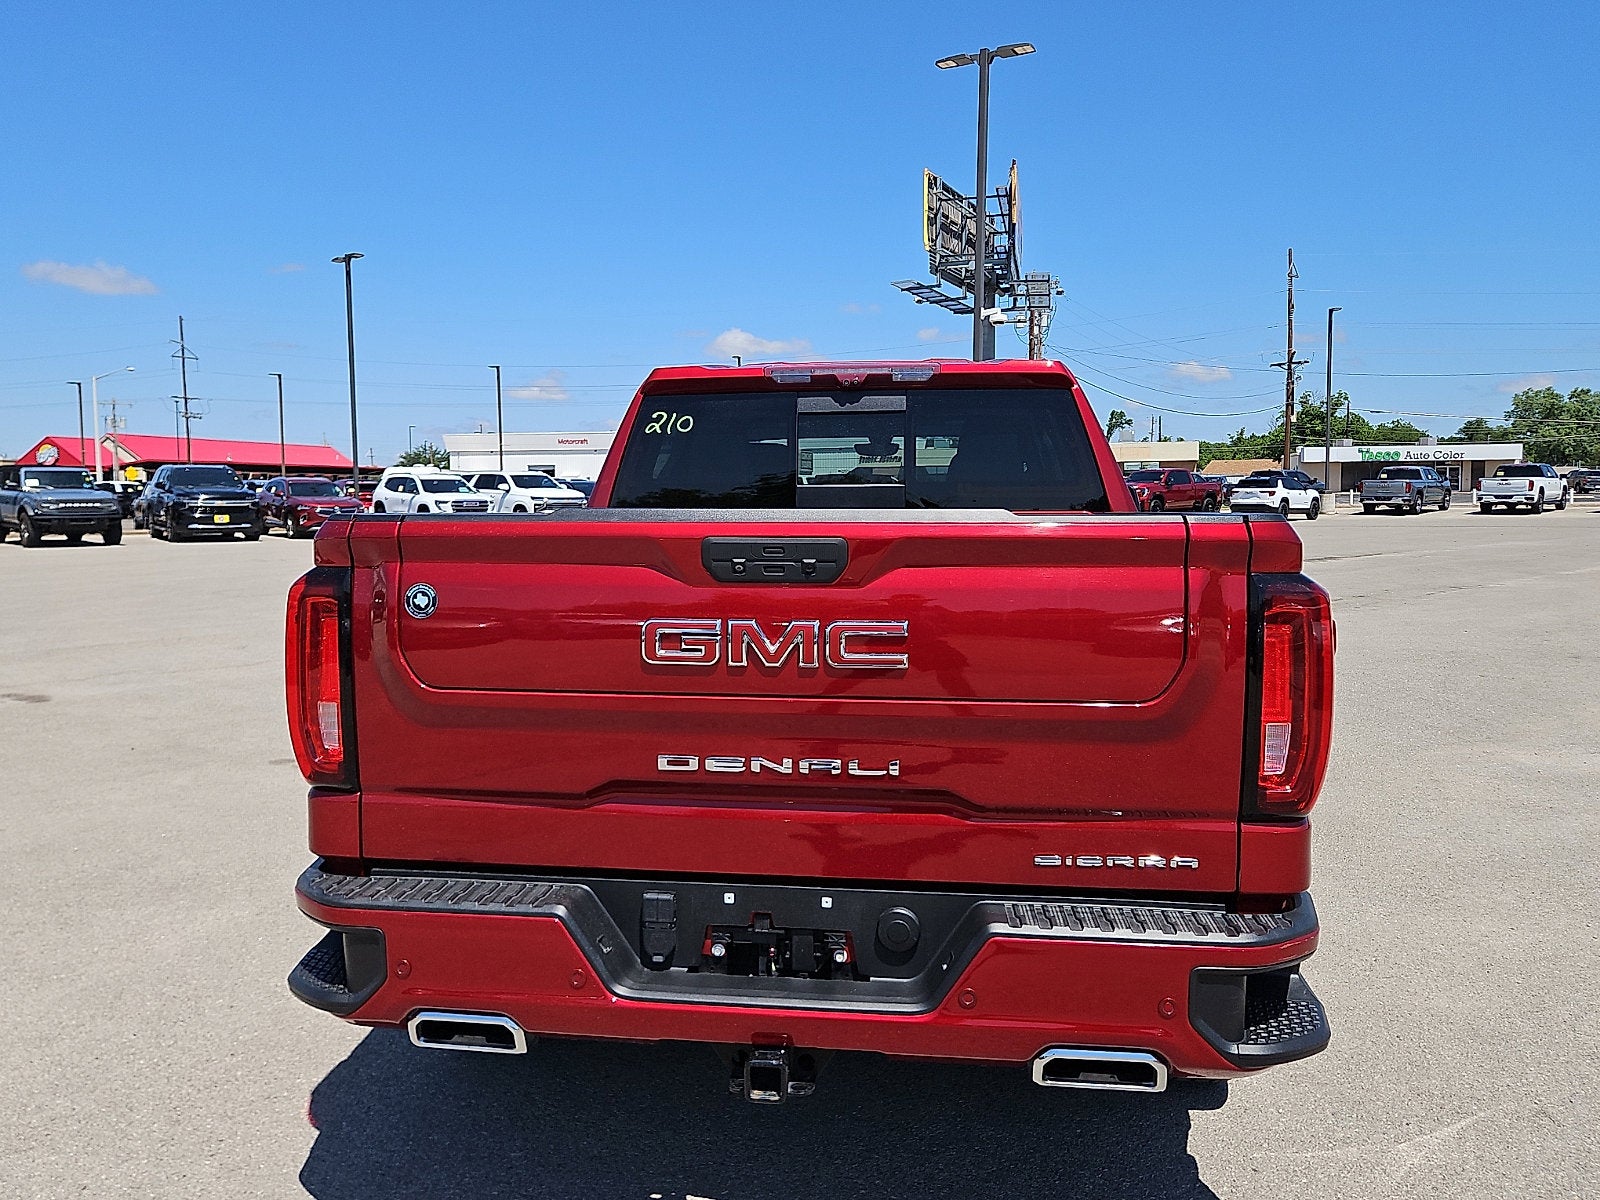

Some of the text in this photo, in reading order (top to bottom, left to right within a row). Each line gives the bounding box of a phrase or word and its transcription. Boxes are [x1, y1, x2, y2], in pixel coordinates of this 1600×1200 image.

[645, 411, 694, 434] 210
[1404, 451, 1430, 460] Auto
[1433, 450, 1465, 460] Color
[641, 618, 909, 669] GMC
[657, 754, 901, 776] DENALI
[1034, 854, 1199, 869] SIERRA
